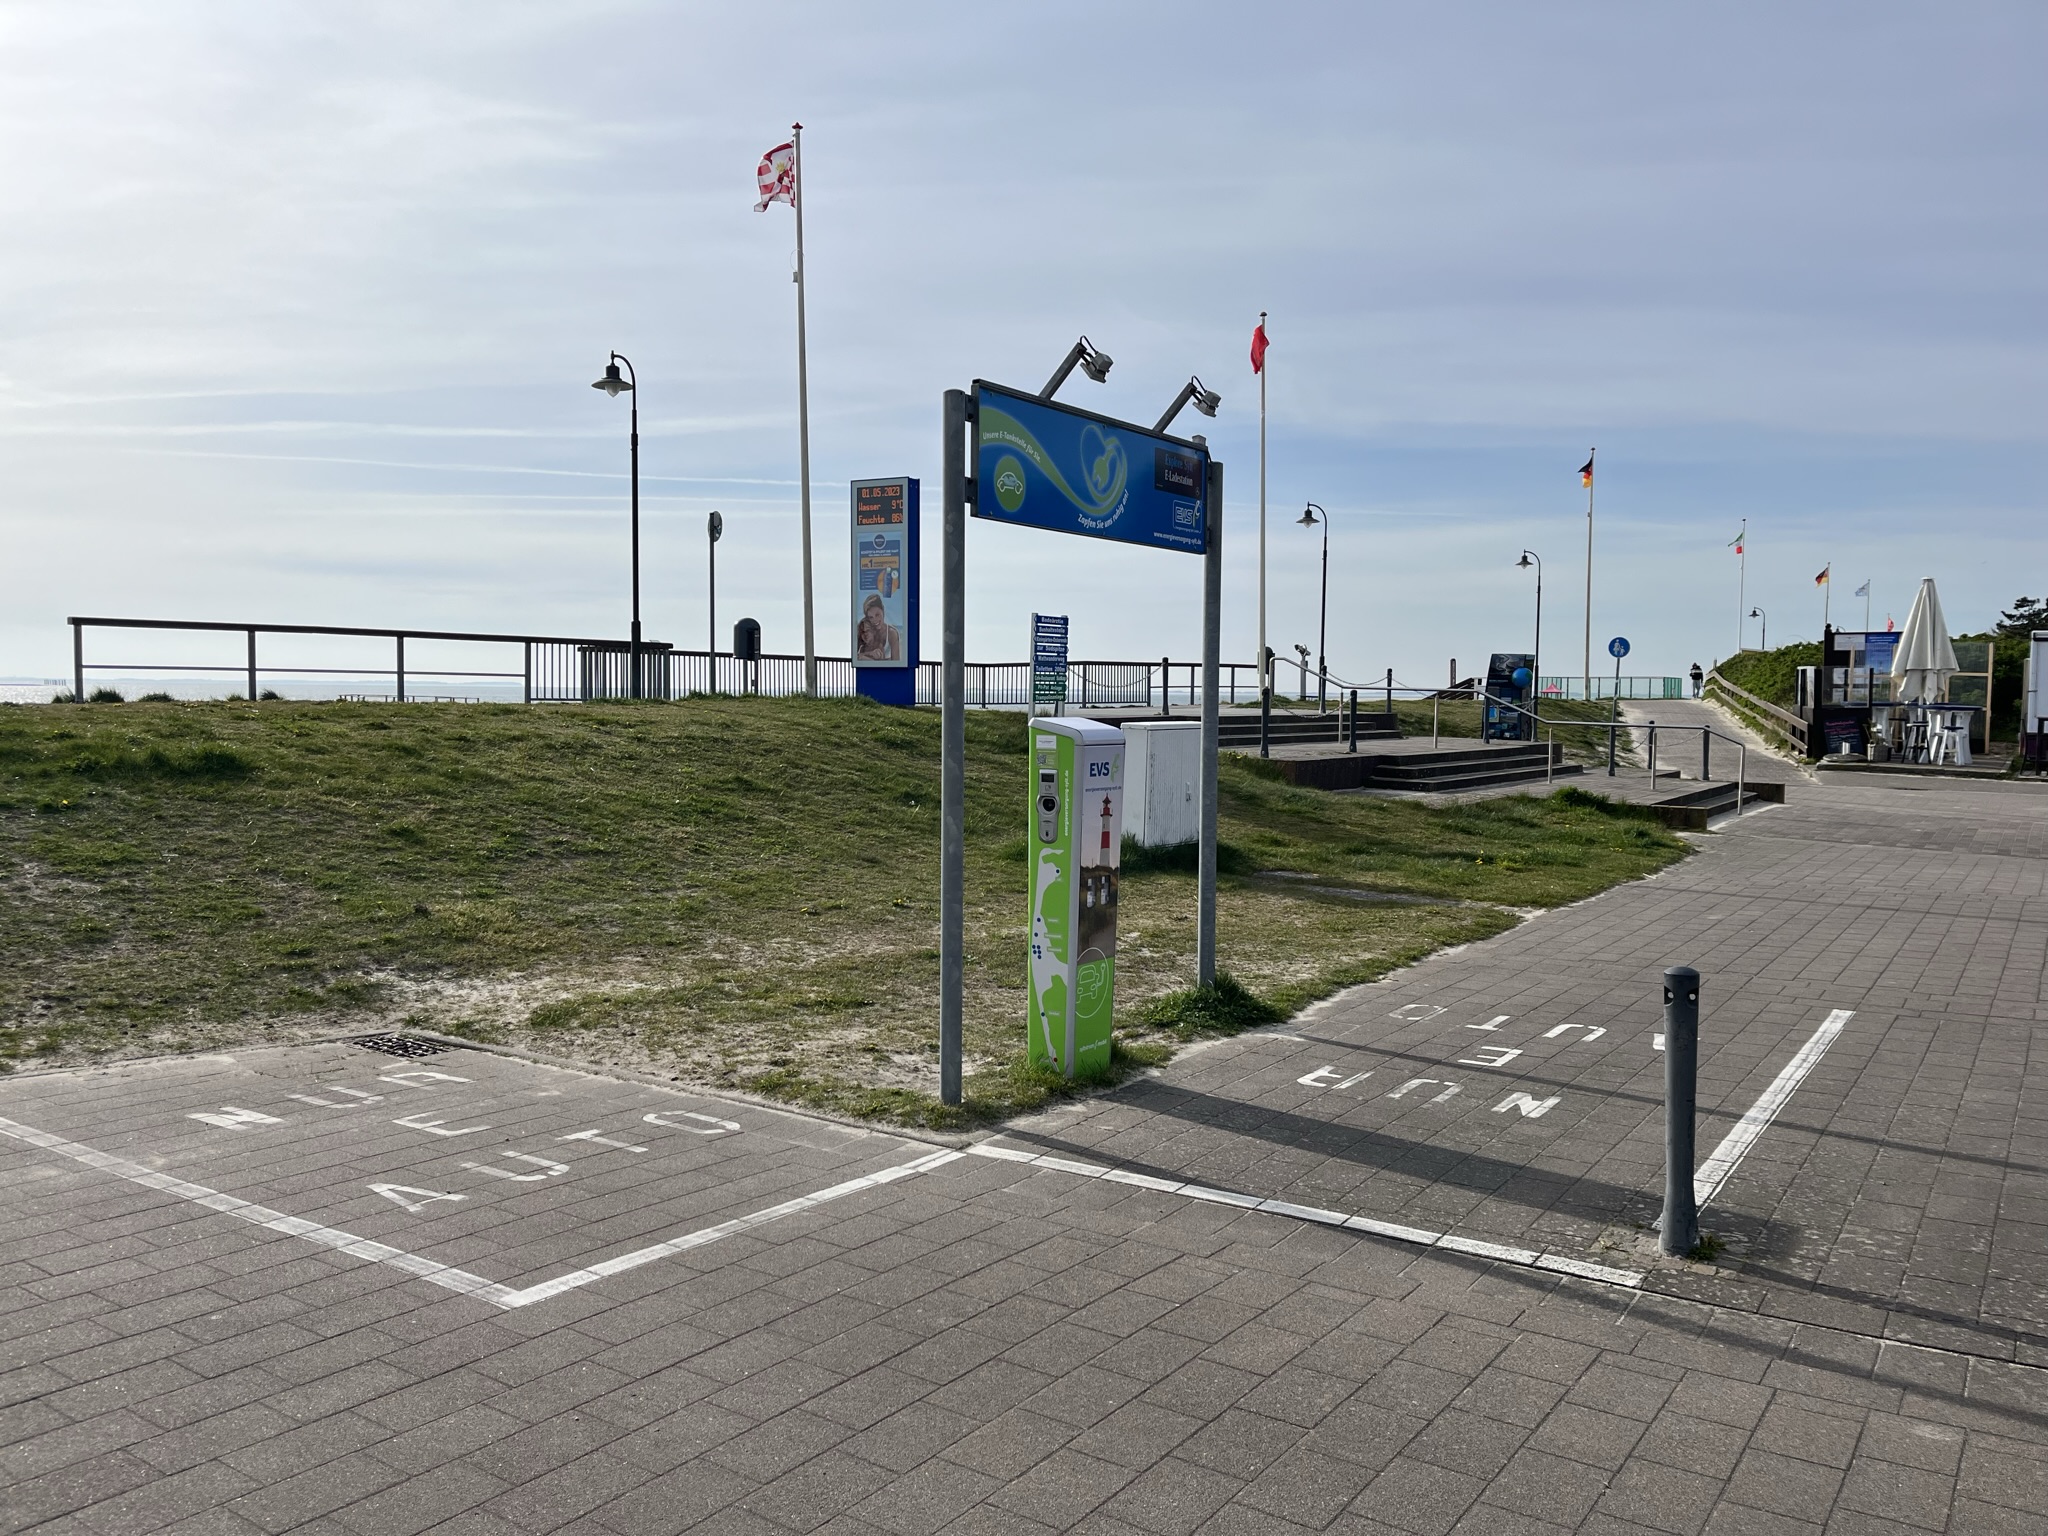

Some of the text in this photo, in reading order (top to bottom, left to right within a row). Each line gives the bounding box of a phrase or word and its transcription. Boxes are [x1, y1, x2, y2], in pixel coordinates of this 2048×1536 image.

[982, 431, 999, 440] Unsere
[1000, 430, 1027, 449] E-Tankstelle
[1164, 469, 1193, 487] E-Ladestation
[861, 486, 900, 498] 01.05.2023
[858, 502, 881, 511] Wasser
[1078, 513, 1096, 529] Zapfen
[1096, 519, 1104, 529] Sie
[1104, 517, 1113, 528] uns
[1112, 503, 1125, 522] ruhig
[858, 514, 885, 525] Feuchte
[1089, 761, 1110, 777] EVS
[186, 1063, 476, 1132] NUR
[1297, 1065, 1563, 1119] NUR
[391, 1112, 493, 1137] E
[365, 1109, 742, 1212] AUTO
